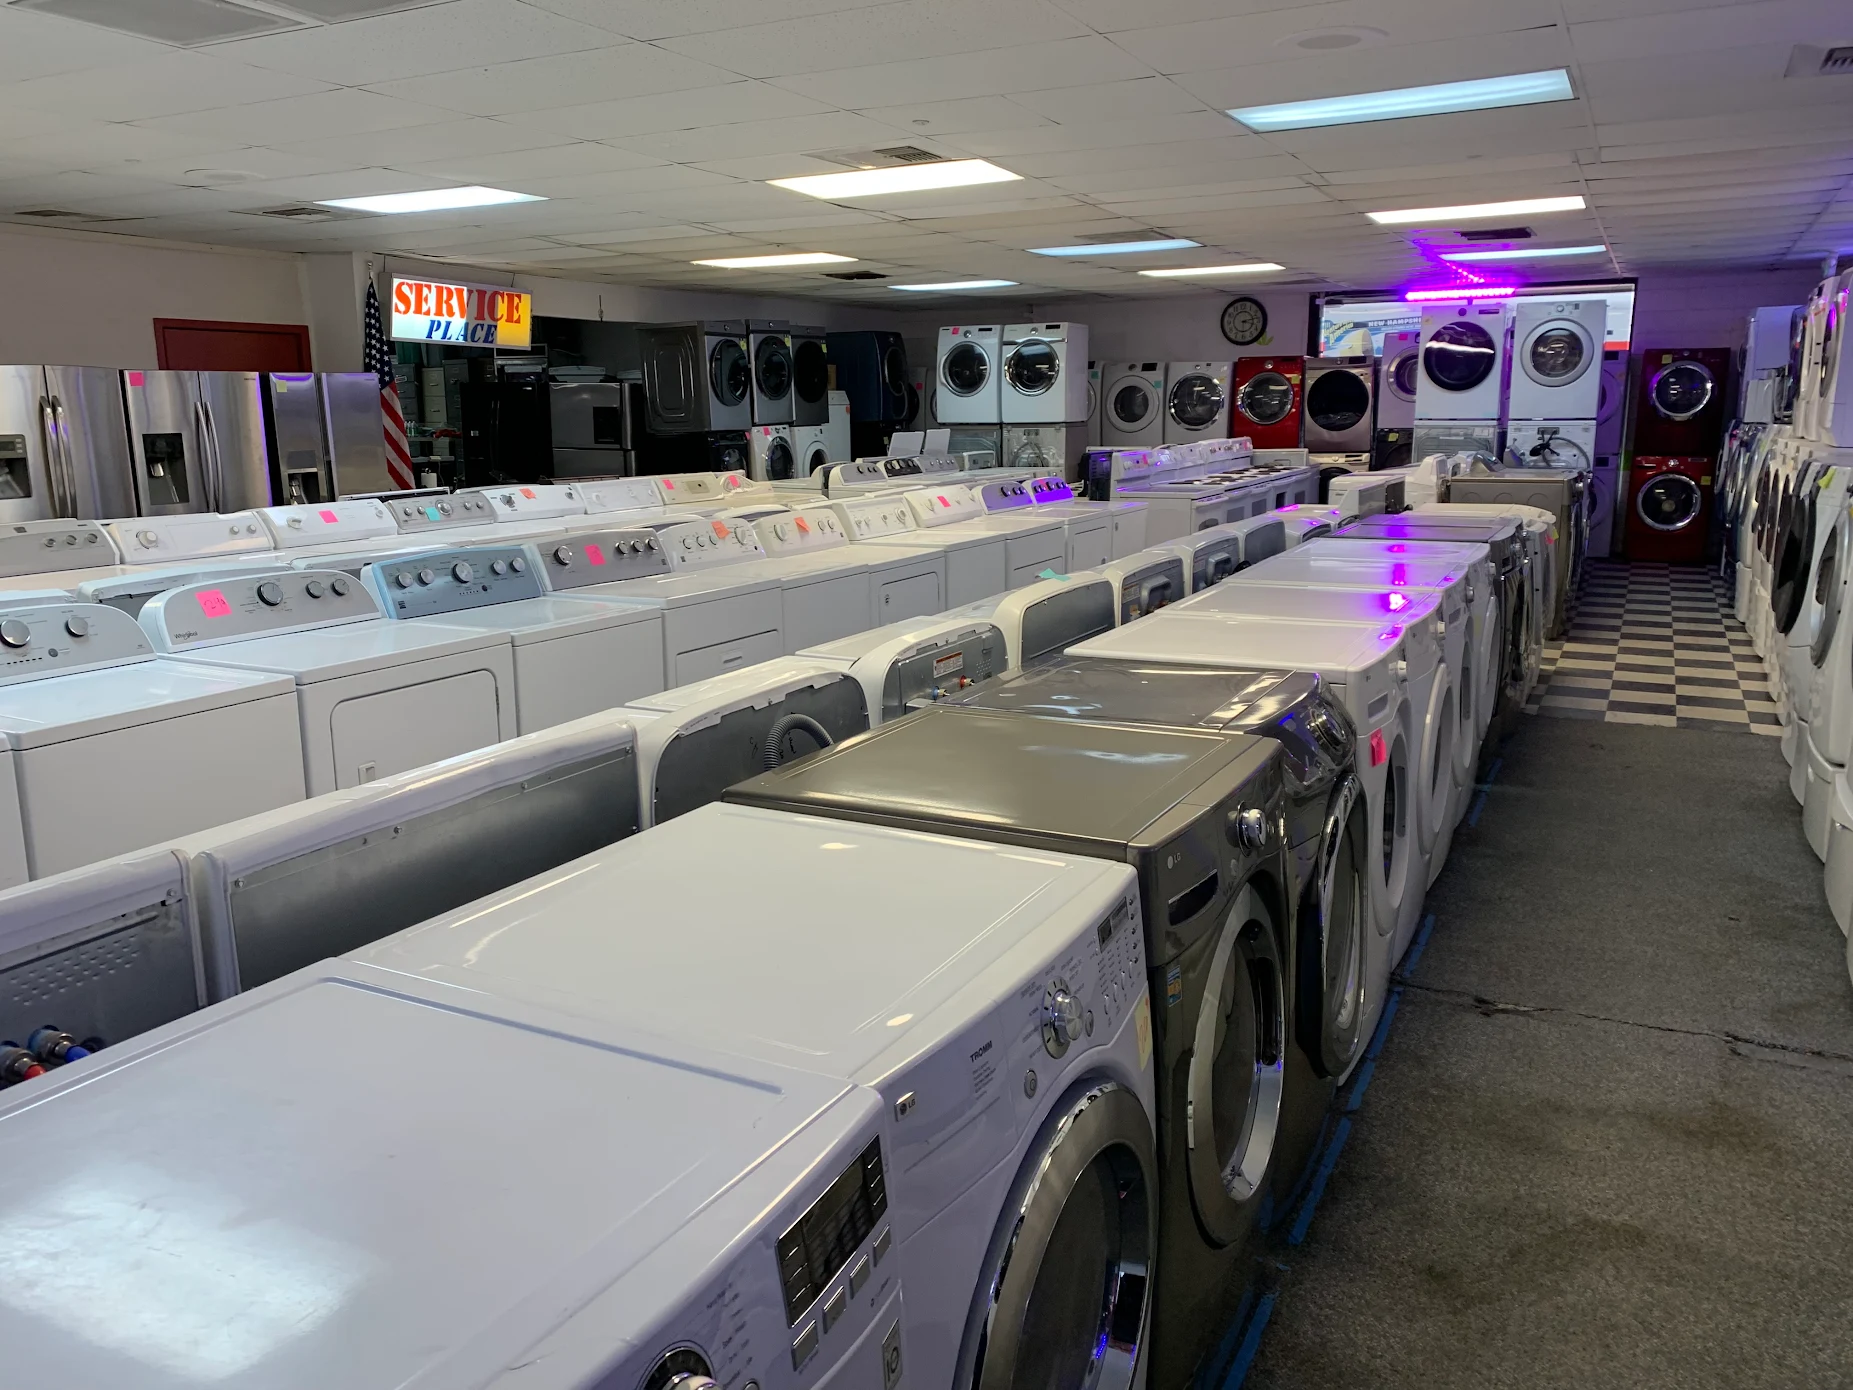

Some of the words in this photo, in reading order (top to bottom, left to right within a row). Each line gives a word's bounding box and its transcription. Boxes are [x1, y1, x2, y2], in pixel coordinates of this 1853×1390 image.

[394, 281, 522, 324] SERVICE
[425, 319, 497, 344] PLACE
[969, 1040, 993, 1063] TROMM
